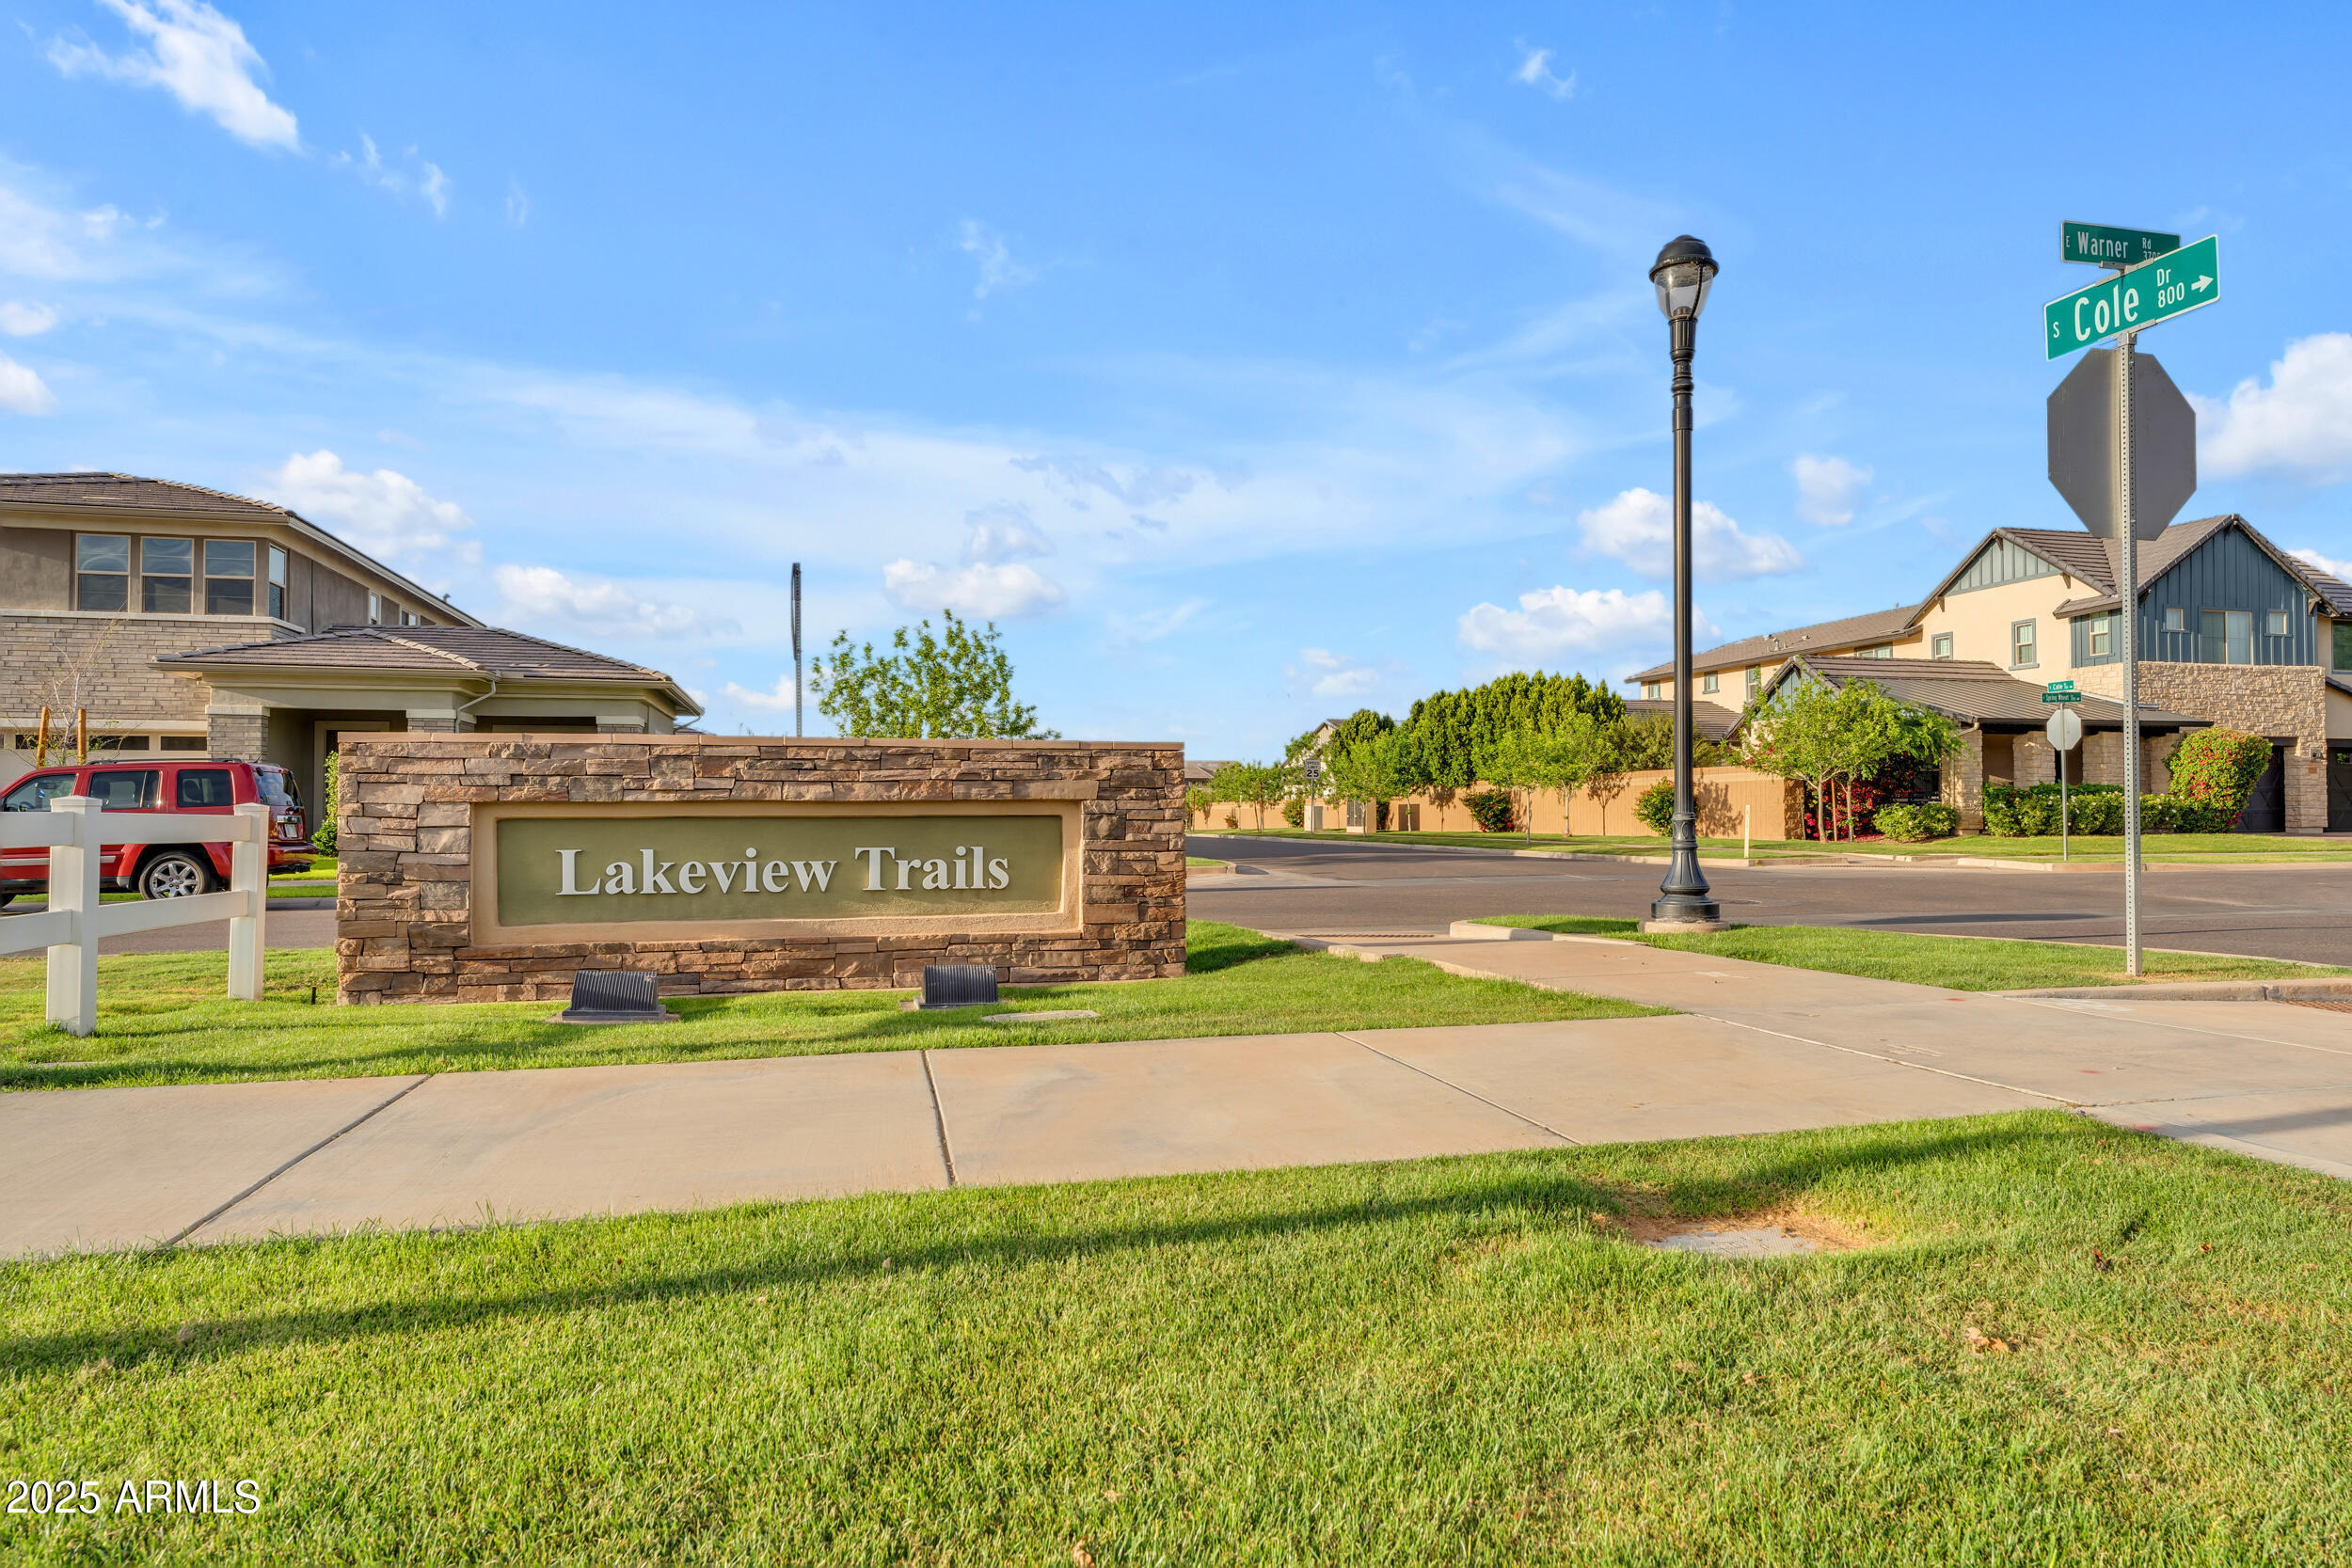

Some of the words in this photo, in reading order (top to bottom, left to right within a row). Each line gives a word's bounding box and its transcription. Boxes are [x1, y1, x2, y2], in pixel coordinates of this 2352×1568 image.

[2065, 235, 2070, 247] E
[2077, 231, 2128, 259] Warner
[2141, 237, 2152, 250] Rd
[2053, 321, 2060, 338] S
[2074, 284, 2139, 341] Cole
[2156, 268, 2171, 287] Dr
[2157, 282, 2185, 309] 800
[555, 847, 838, 895] Lakeview
[854, 846, 1009, 892] Trails
